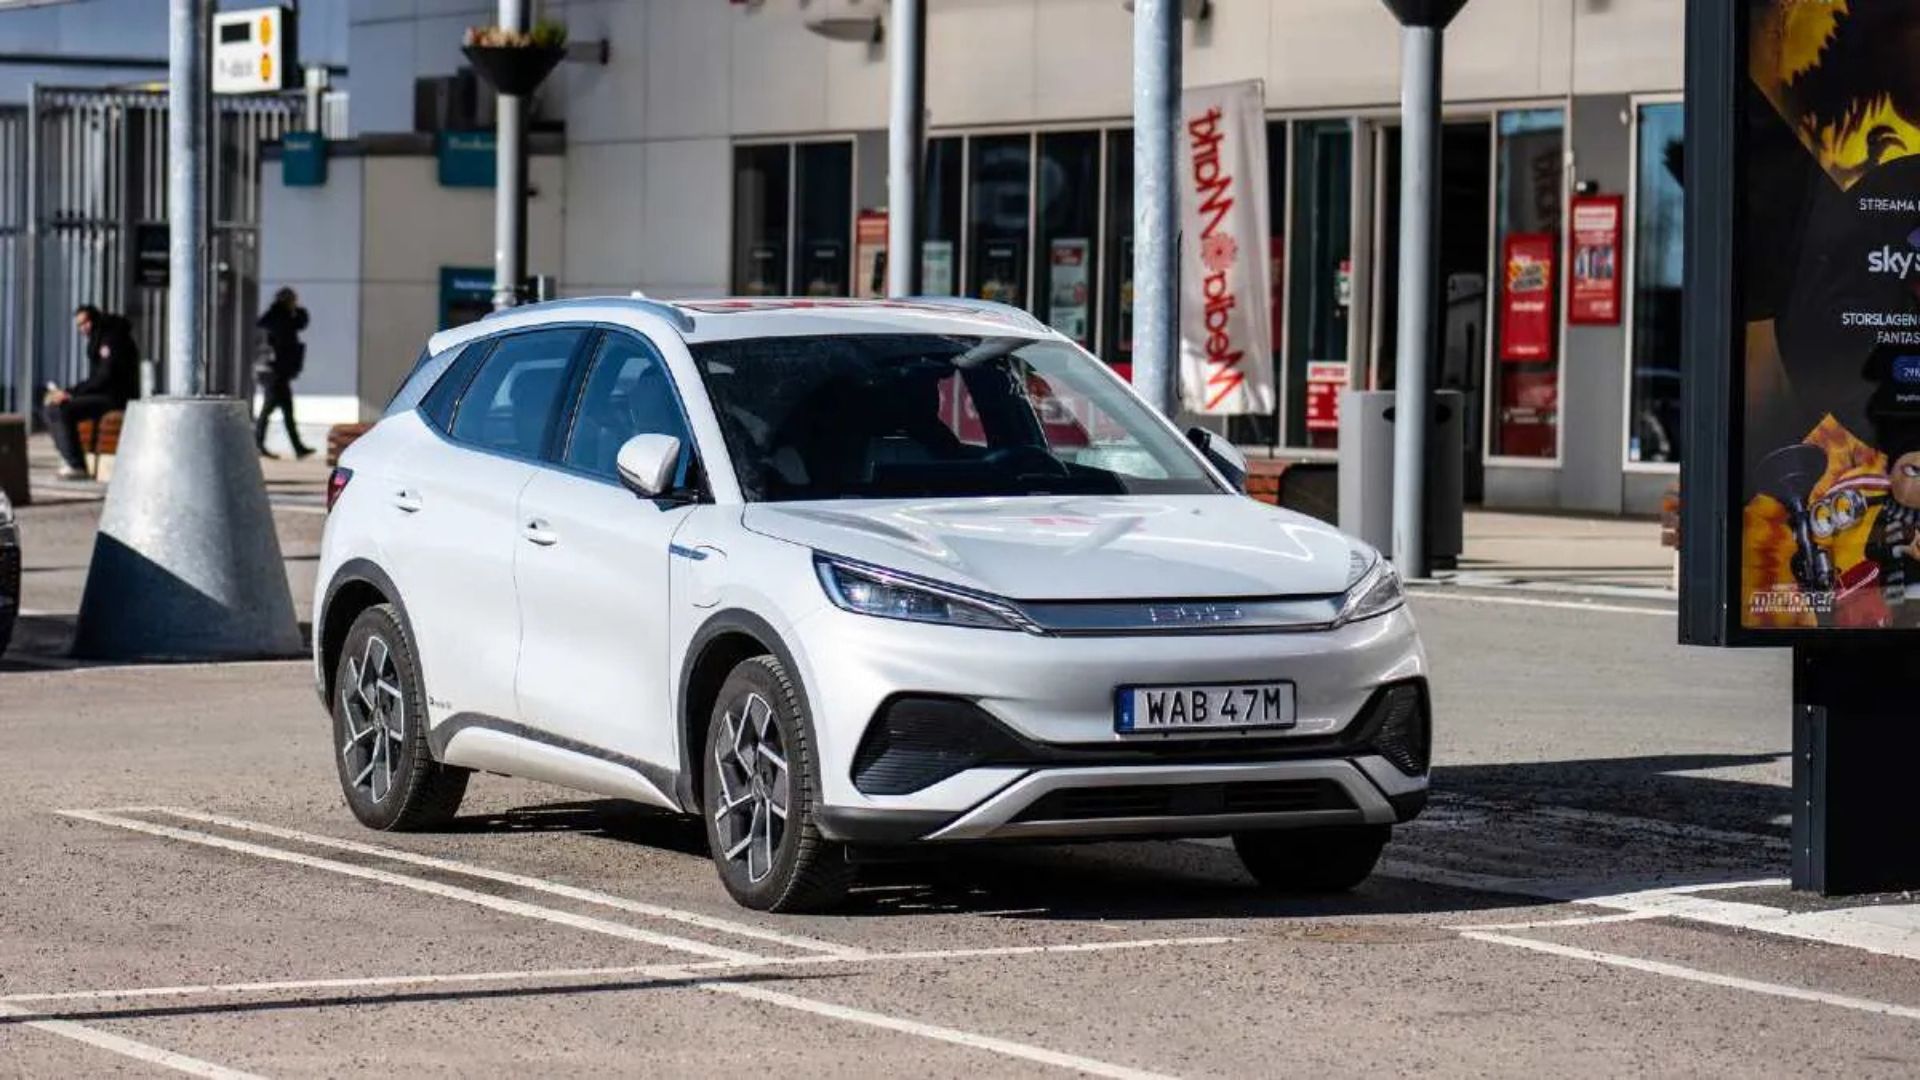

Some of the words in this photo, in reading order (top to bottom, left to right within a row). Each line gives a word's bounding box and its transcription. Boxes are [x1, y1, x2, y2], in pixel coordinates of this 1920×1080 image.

[1859, 198, 1915, 211] STREAMA
[1868, 244, 1914, 279] sky
[1842, 312, 1917, 326] STORSLAGEN
[1146, 690, 1207, 724] WAB
[1219, 687, 1281, 722] 47M
